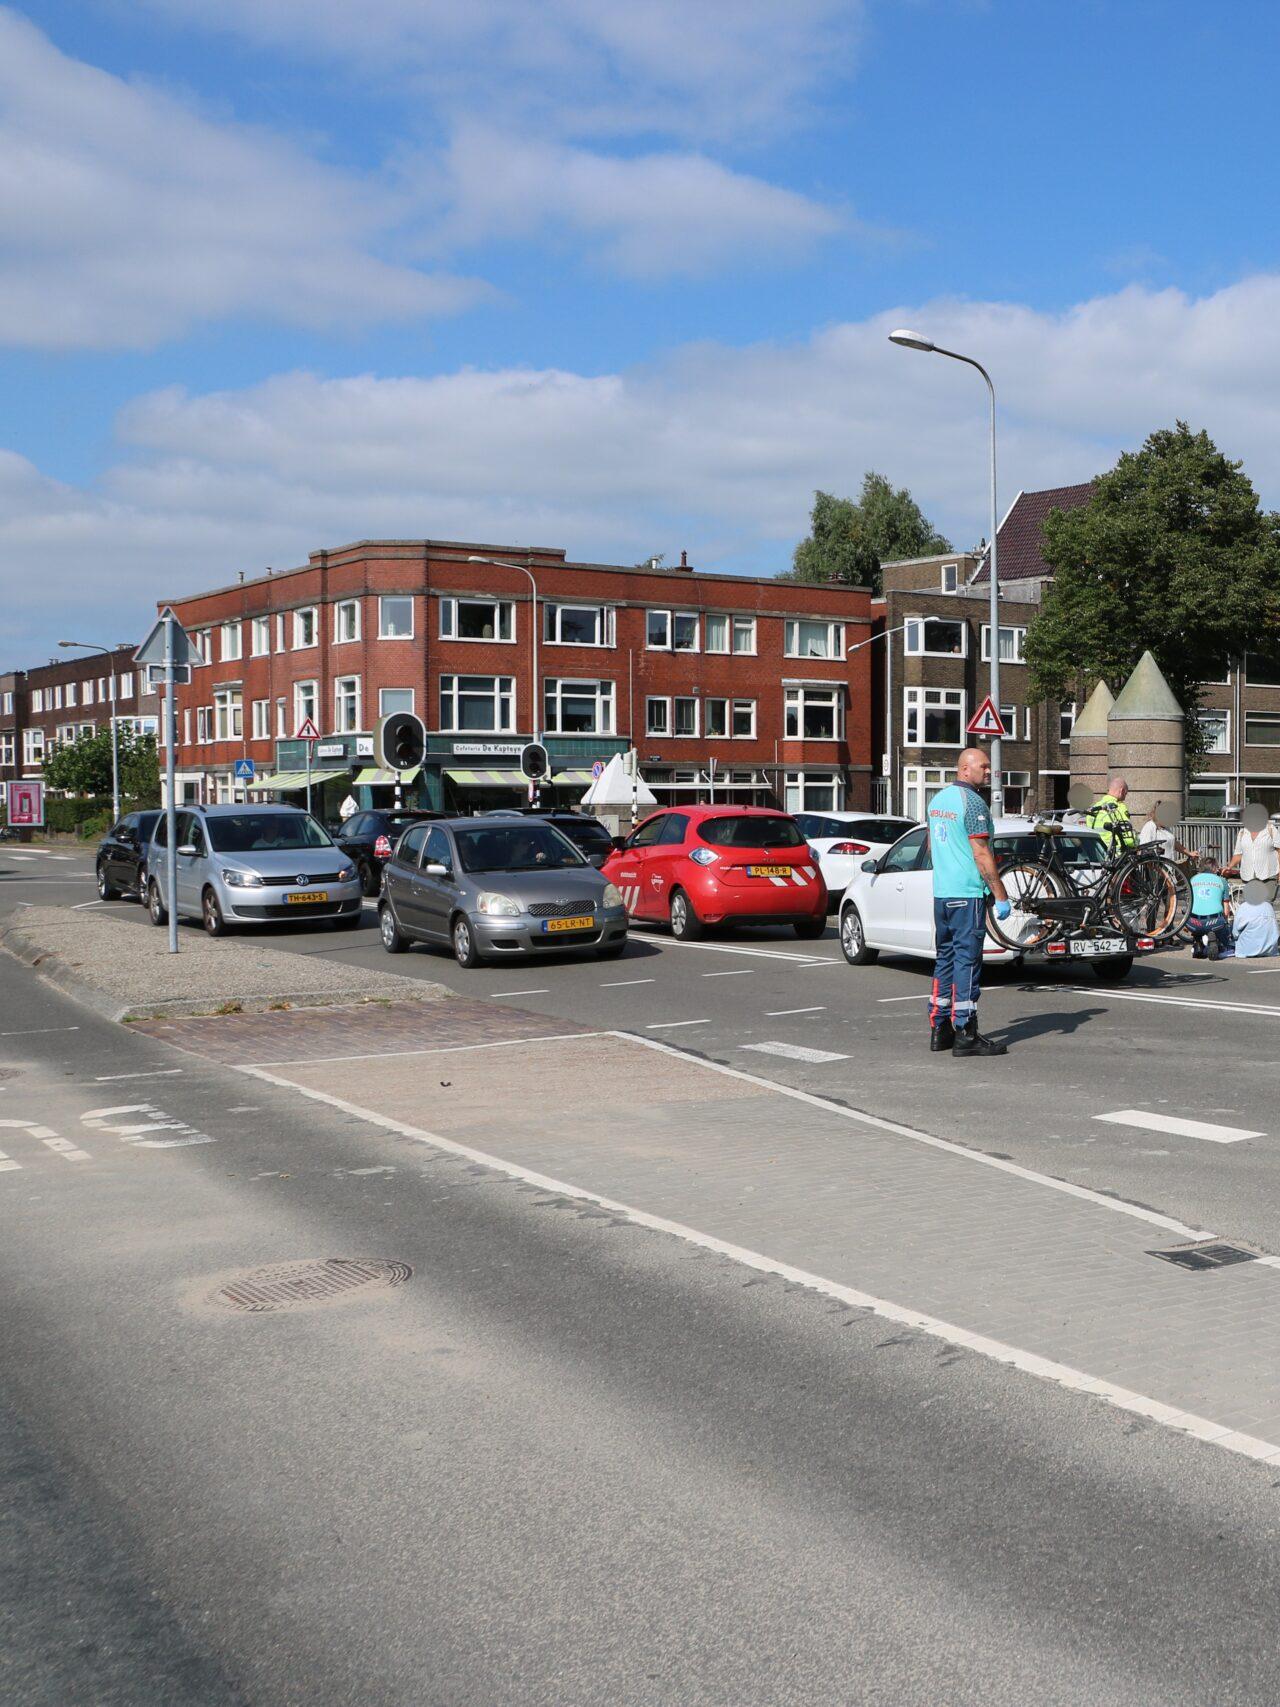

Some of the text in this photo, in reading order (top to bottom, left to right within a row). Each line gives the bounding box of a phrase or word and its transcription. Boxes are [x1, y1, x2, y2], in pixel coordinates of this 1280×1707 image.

[289, 893, 324, 902] TH-643-S
[550, 917, 590, 930] 65-LR-NT
[1073, 940, 1125, 953] RV-542-Z
